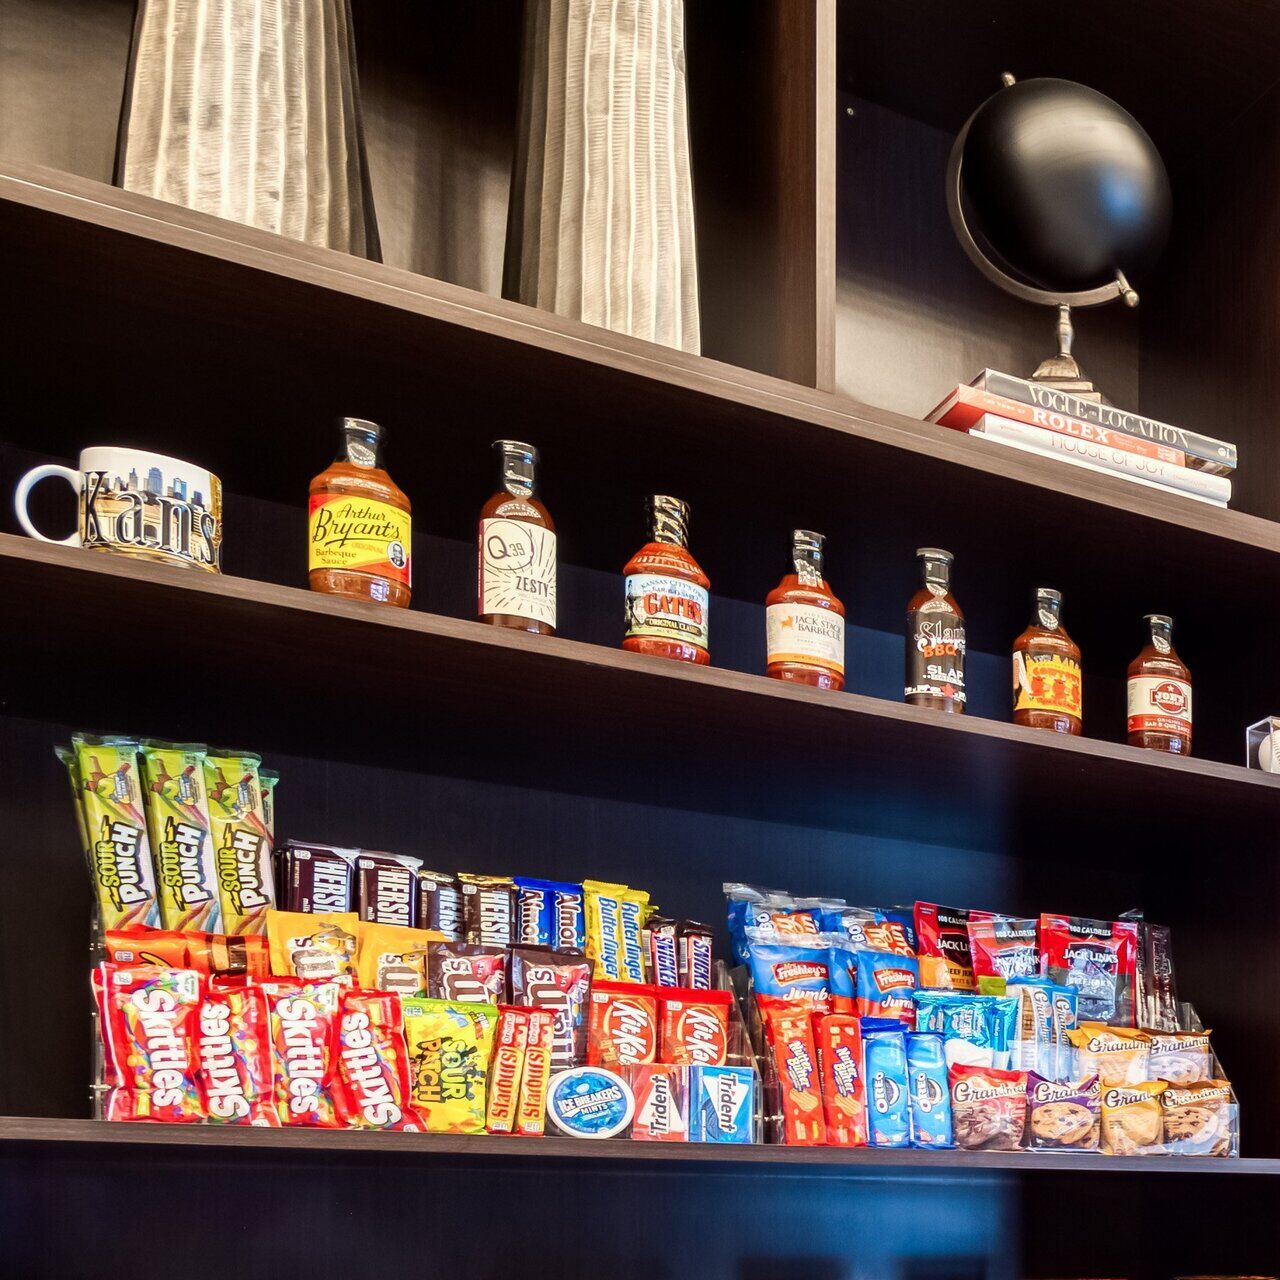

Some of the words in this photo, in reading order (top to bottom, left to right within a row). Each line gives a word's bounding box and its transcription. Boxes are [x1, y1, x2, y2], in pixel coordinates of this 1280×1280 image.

[1026, 385, 1087, 417] VOGUE
[1097, 402, 1190, 448] LOCATION
[1033, 408, 1110, 444] ROLEX
[1051, 435, 1107, 462] HOUSE
[1111, 452, 1130, 466] OF
[1135, 457, 1164, 476] JOY
[312, 508, 402, 549] Bryant's
[337, 503, 386, 521] Arthur
[516, 575, 549, 598] ZESTY
[795, 615, 819, 626] JACK
[923, 643, 957, 658] BBQ
[927, 664, 964, 679] SLAP
[95, 841, 120, 888] SOUR
[110, 821, 149, 905] PUNCH
[159, 841, 182, 888] SOUR
[174, 821, 213, 905] PUNCH
[217, 846, 242, 893] SOUR
[234, 827, 271, 909] PUNCH
[597, 895, 620, 979] Butterfinger
[621, 901, 643, 982] Butterfinger
[1063, 949, 1089, 960] JACK
[131, 988, 190, 1107] Skittles
[200, 1003, 251, 1119] Skittles
[275, 998, 325, 1115] Skittles
[343, 1012, 402, 1126] Skittles
[417, 1036, 446, 1103] PATCH
[440, 1036, 468, 1101] SOUR
[560, 1099, 575, 1117] ICE
[575, 1085, 622, 1108] BREAKERS
[581, 1102, 608, 1115] MINTS
[649, 1074, 670, 1135] Trident
[720, 1073, 737, 1133] Trident
[874, 1071, 889, 1114] OREO
[916, 1071, 932, 1113] OREO
